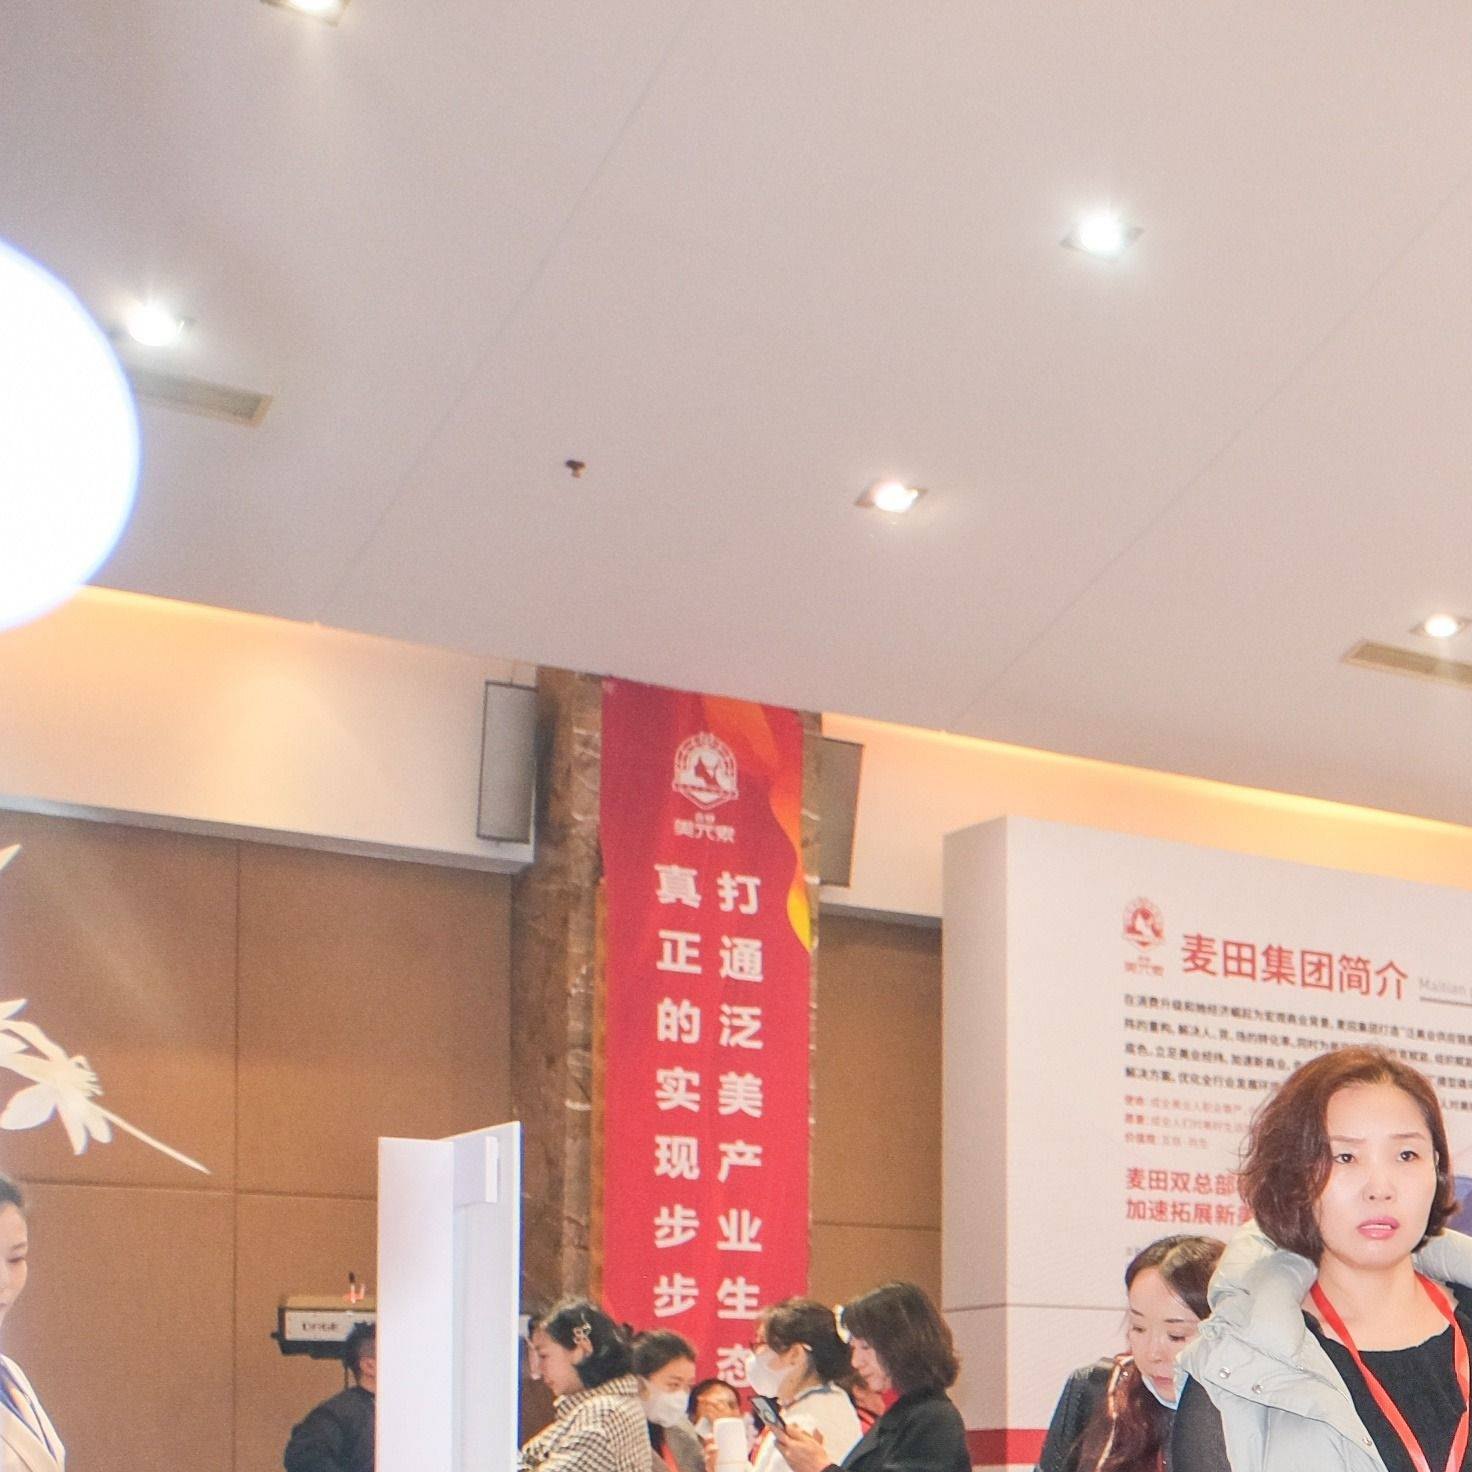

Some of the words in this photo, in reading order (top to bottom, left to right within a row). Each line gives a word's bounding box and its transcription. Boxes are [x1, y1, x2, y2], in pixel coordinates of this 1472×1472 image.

[653, 863, 702, 1318] 真正的实现步步
[1181, 932, 1409, 1000] 麦田集团简介
[716, 871, 764, 1386] 打通泛美产业生态
[1126, 1168, 1238, 1196] 麦田双总部
